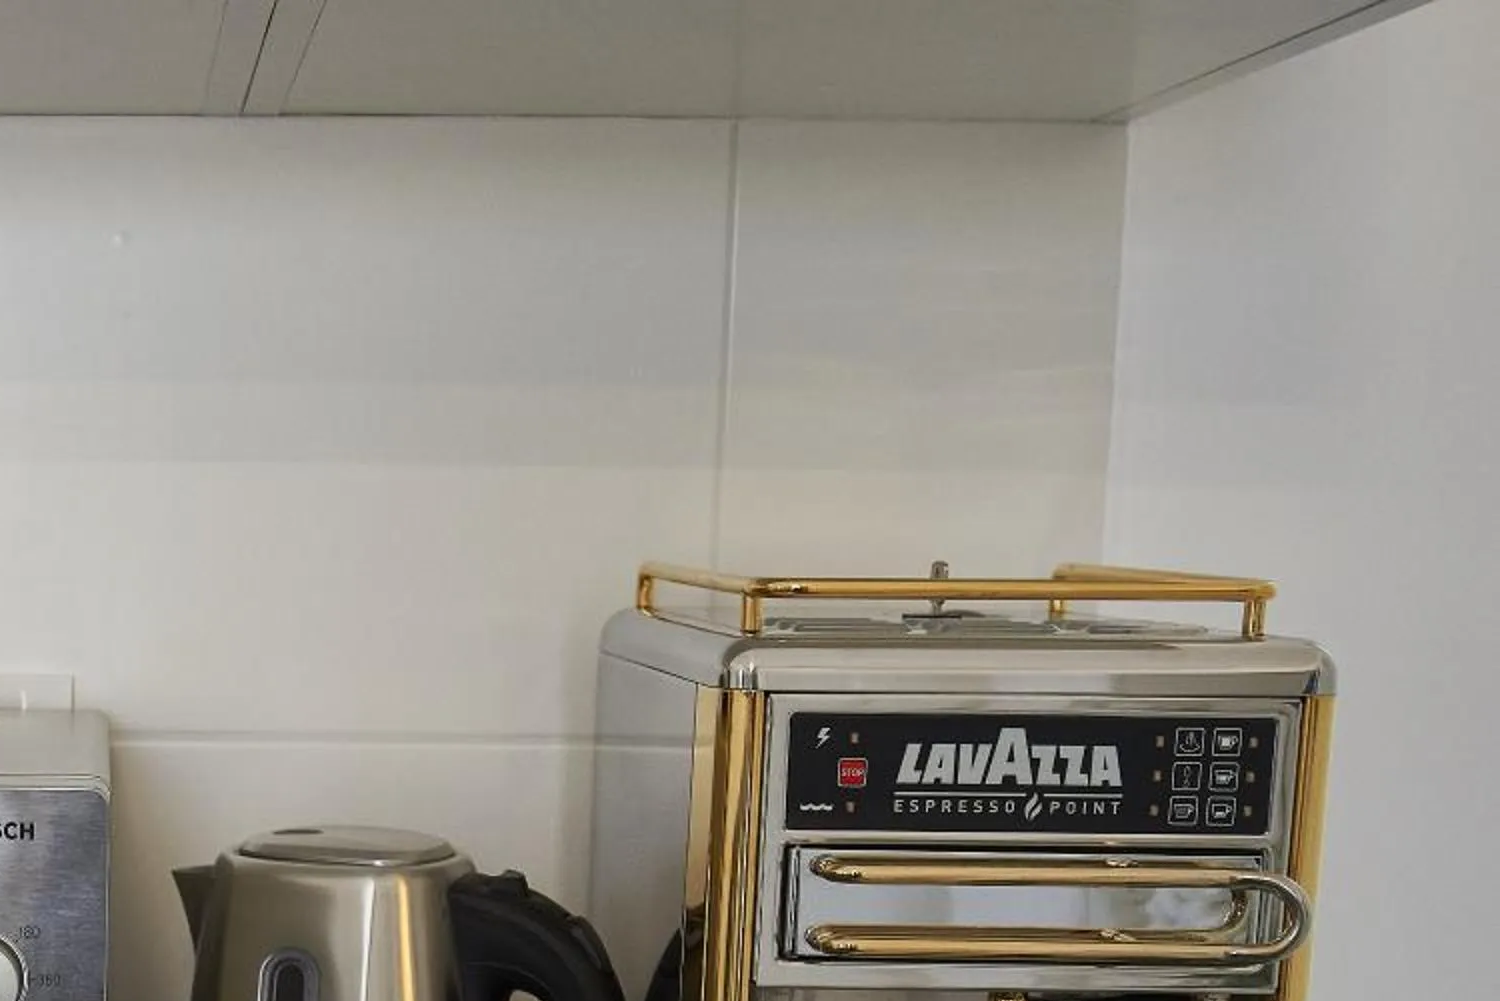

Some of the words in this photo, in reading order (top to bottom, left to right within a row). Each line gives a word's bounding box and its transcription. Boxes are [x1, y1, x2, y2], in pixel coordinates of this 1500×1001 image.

[896, 727, 1122, 787] LAVAZZA
[841, 767, 866, 777] STOP
[894, 799, 1015, 813] ESPRESSO
[1049, 801, 1121, 815] POINT
